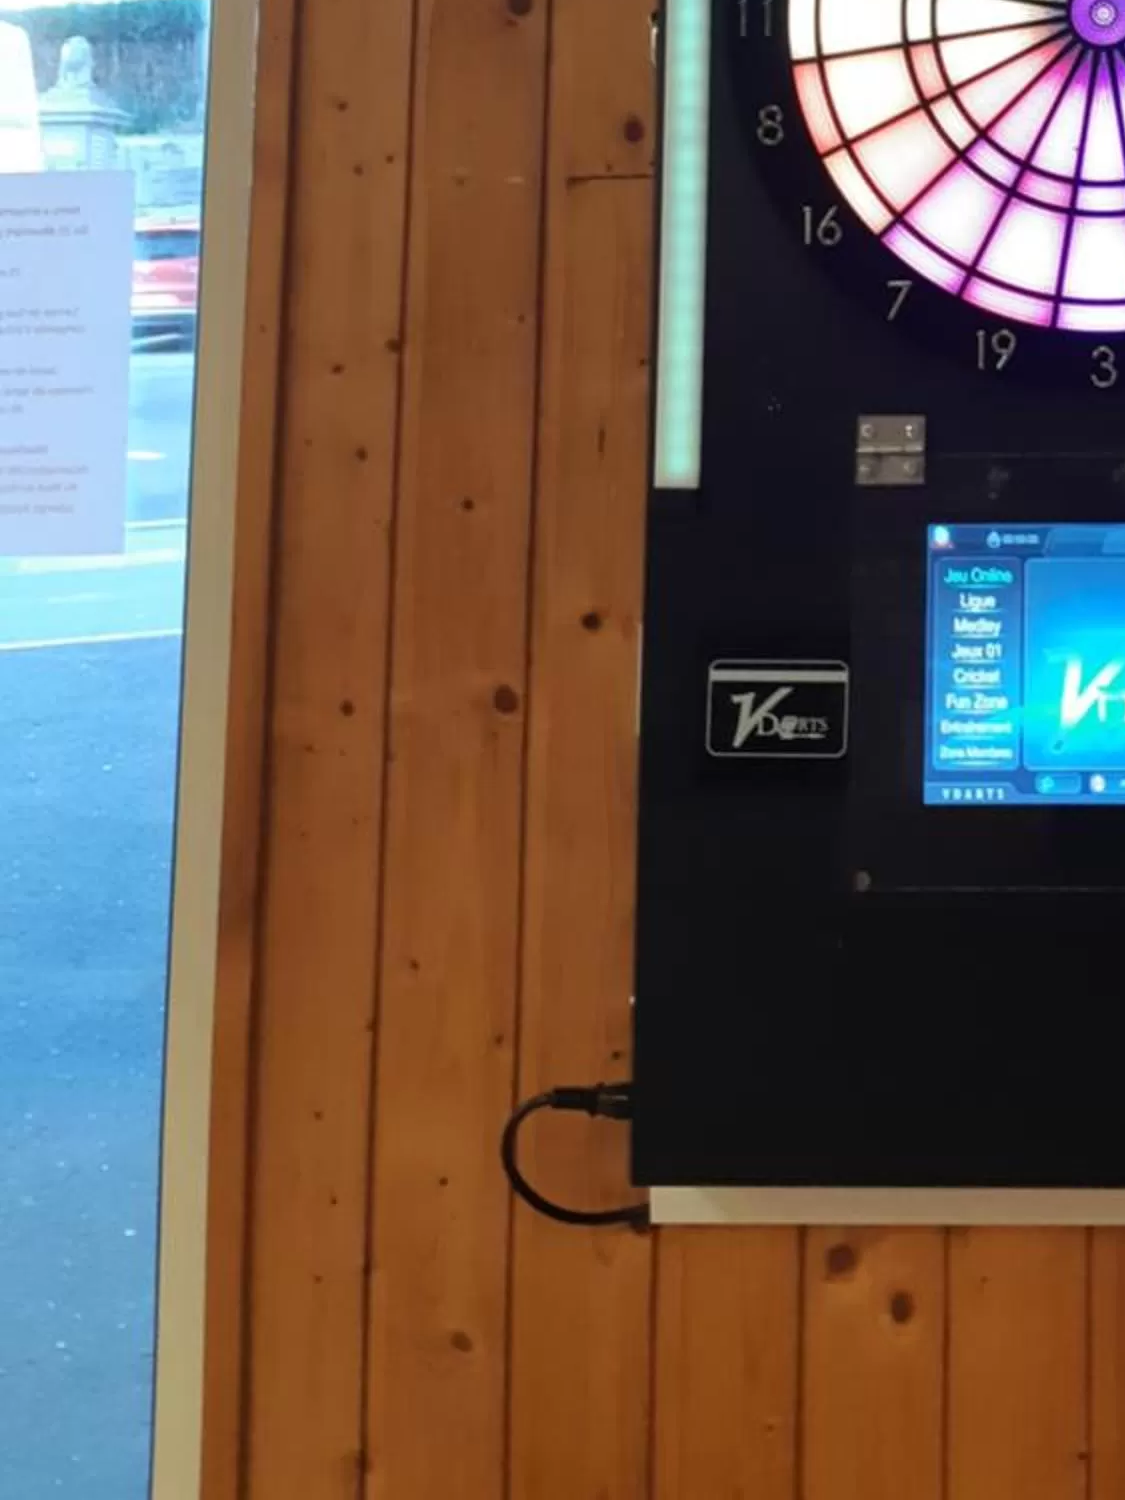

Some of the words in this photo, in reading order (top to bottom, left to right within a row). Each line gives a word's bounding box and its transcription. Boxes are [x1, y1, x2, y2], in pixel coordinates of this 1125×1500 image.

[756, 104, 784, 146] 8
[801, 205, 843, 246] 16
[886, 280, 913, 321] 7
[975, 328, 1017, 371] 19
[1090, 345, 1118, 388] 3
